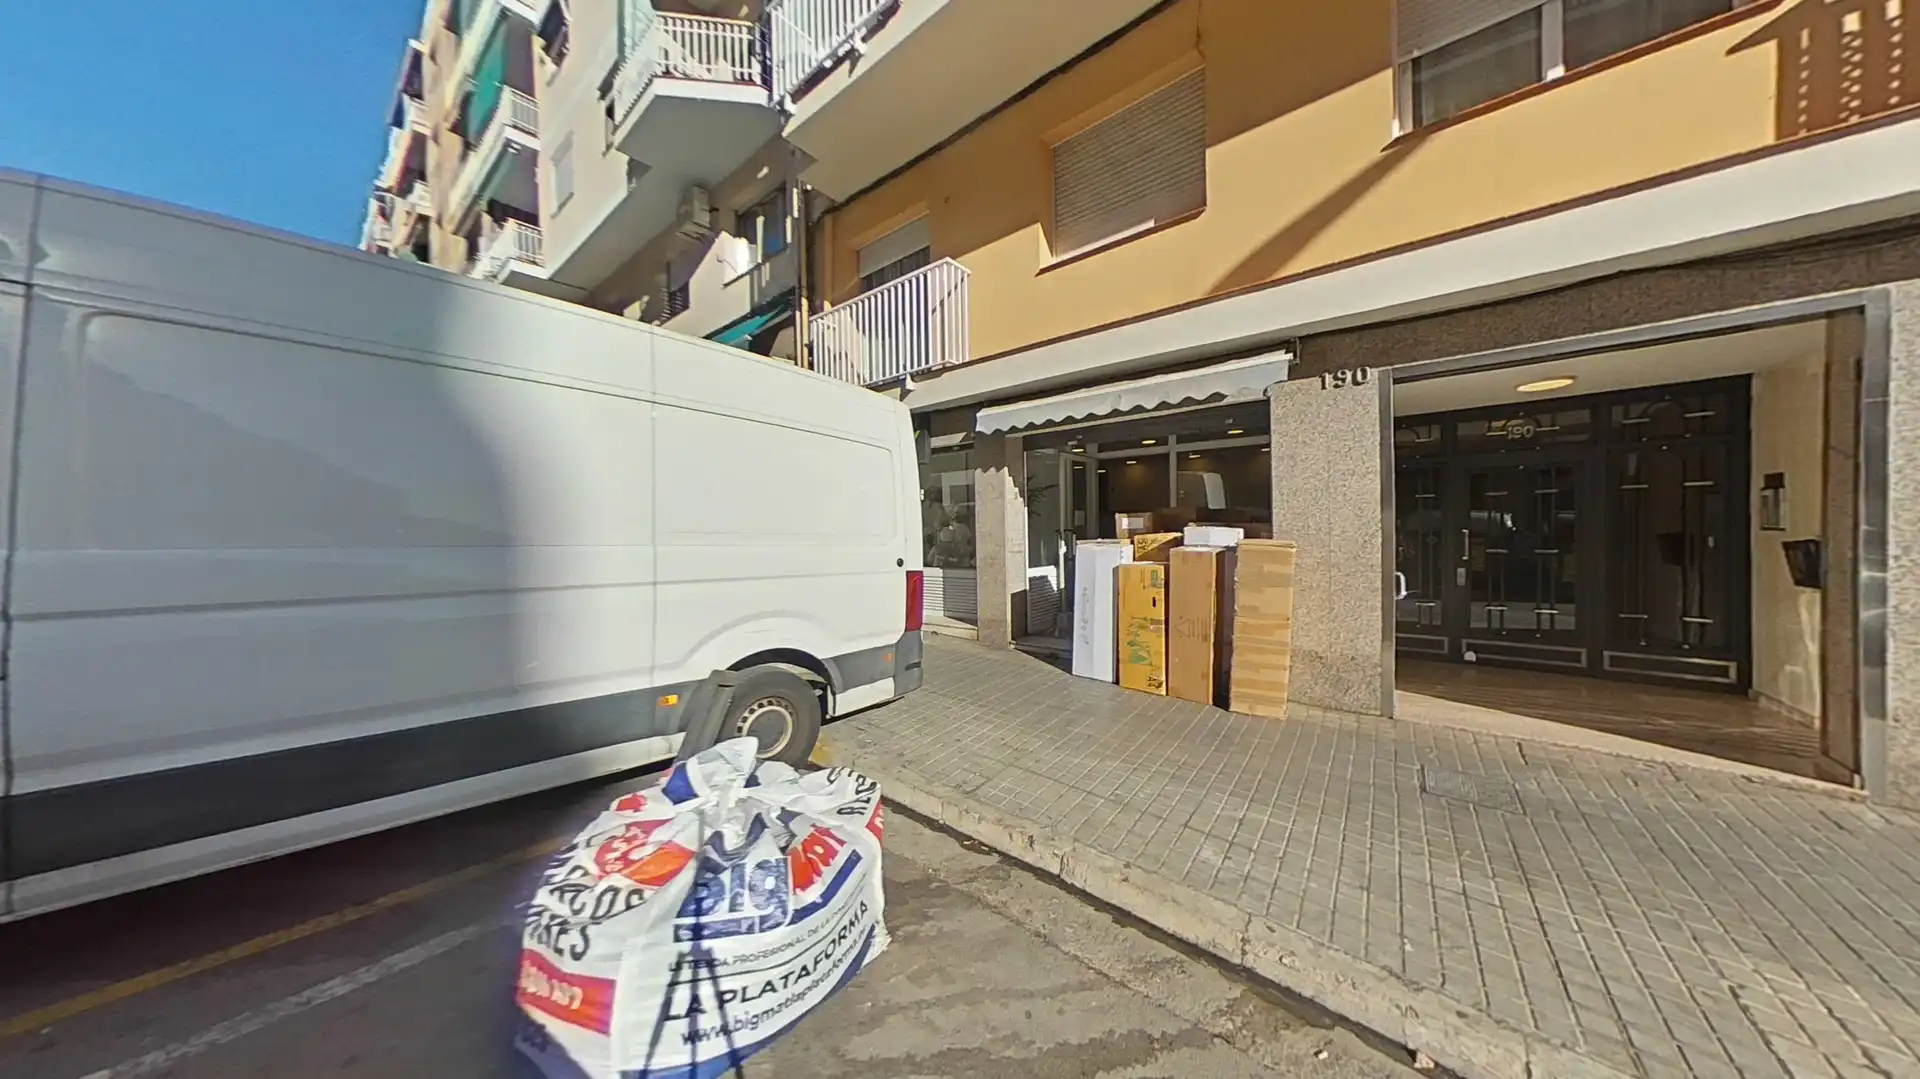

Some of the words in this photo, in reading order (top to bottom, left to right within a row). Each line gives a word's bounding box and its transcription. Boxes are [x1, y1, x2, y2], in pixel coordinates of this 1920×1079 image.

[1319, 366, 1371, 390] 190
[1507, 425, 1534, 439] 190
[716, 899, 868, 1012] PLATAFORMA
